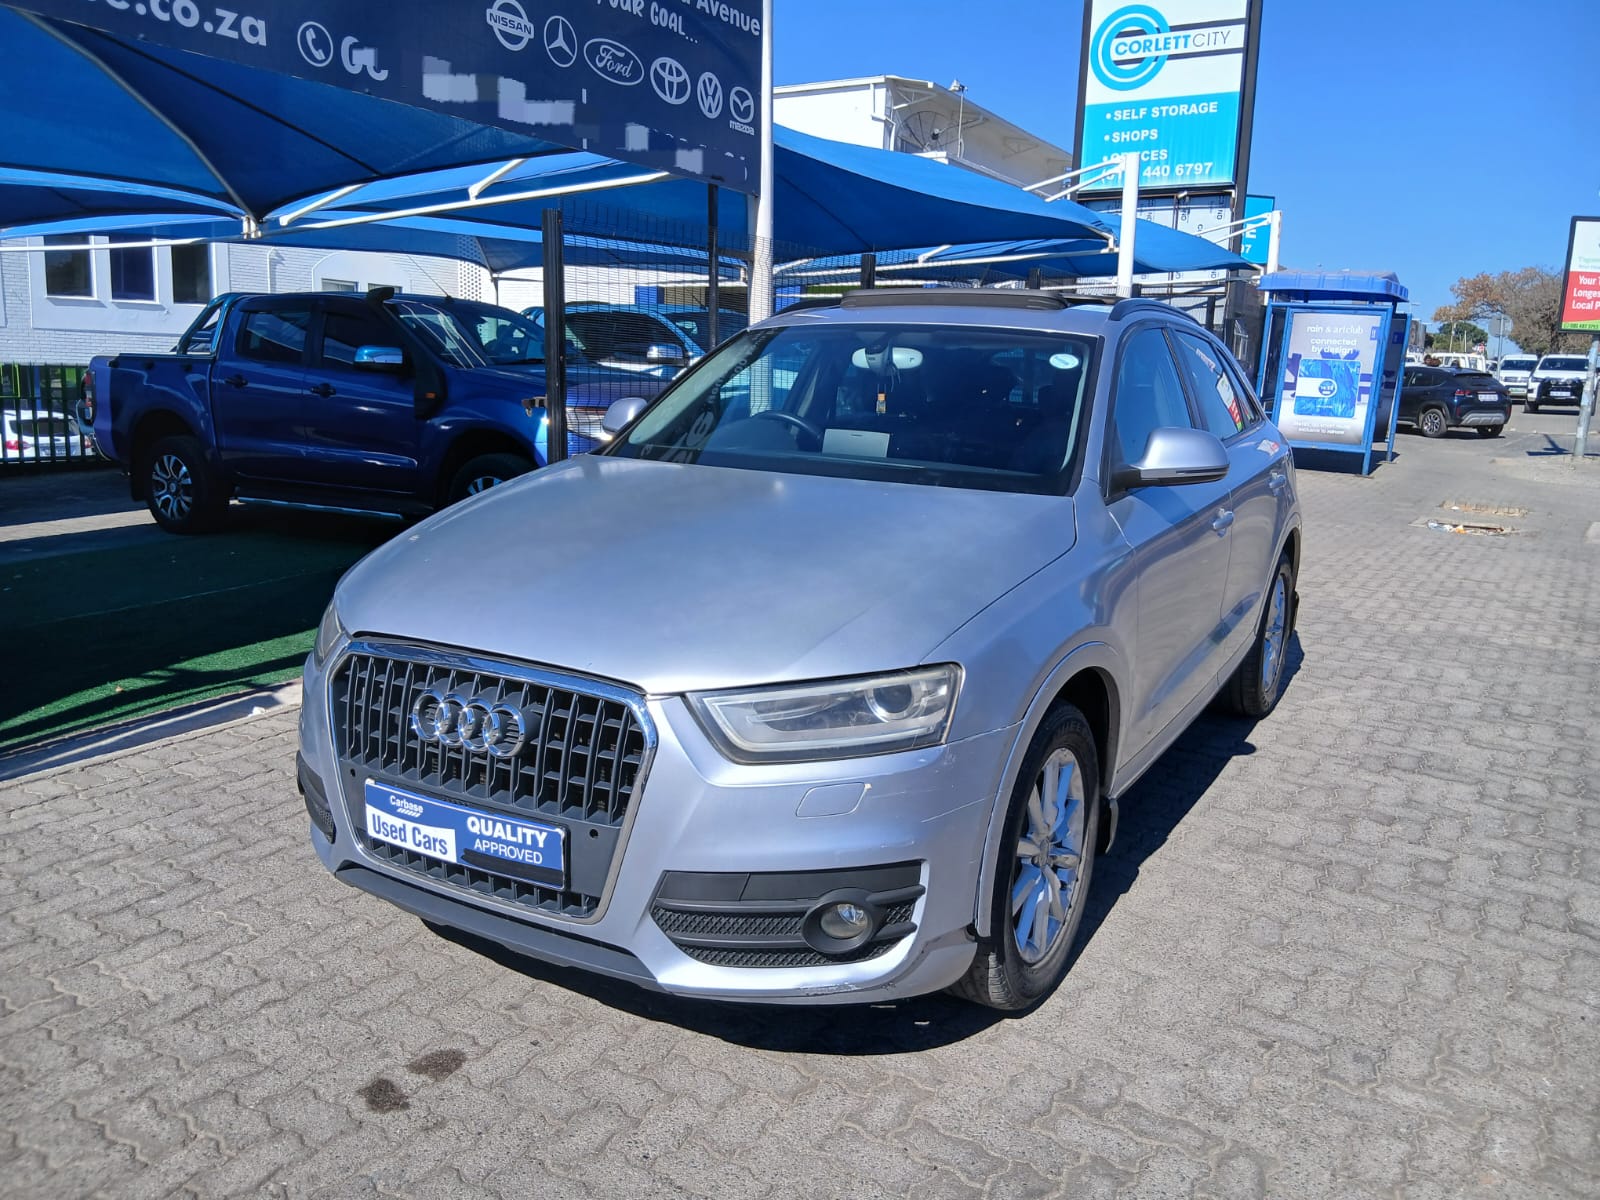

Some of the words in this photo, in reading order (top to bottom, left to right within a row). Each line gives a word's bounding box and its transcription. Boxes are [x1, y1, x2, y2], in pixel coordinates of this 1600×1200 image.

[489, 13, 532, 35] NISSAN
[595, 44, 634, 78] Ford
[1113, 107, 1147, 121] SELF
[1151, 101, 1218, 118] STORAGE
[1111, 129, 1158, 143] SHOPS
[1142, 164, 1170, 178] 440
[1175, 162, 1213, 176] 6797
[1579, 275, 1597, 286] Your
[1572, 300, 1593, 310] Local
[1311, 337, 1357, 346] connected
[389, 795, 424, 813] Carbase
[372, 813, 408, 842] Used
[412, 825, 448, 856] Cars
[466, 816, 548, 848] QUALITY
[474, 838, 543, 865] APPROVED
